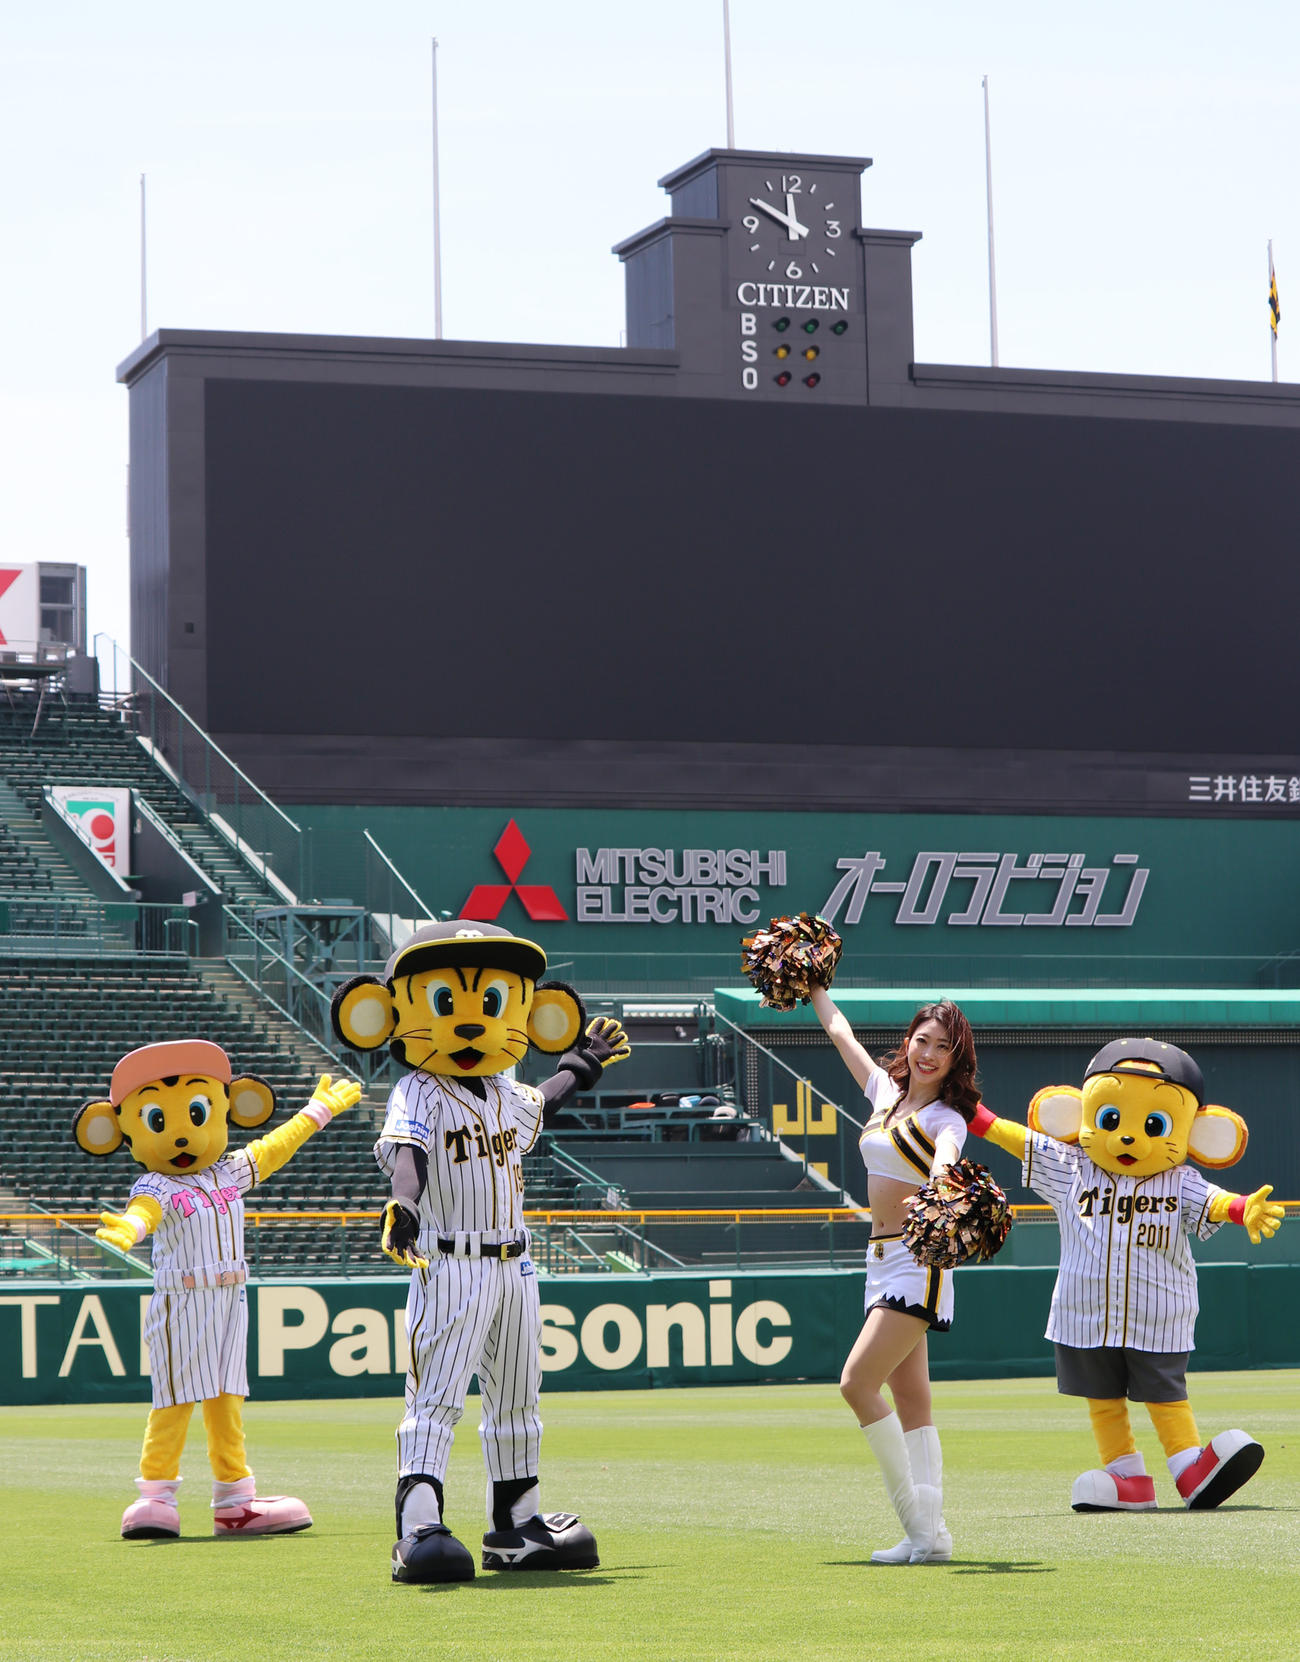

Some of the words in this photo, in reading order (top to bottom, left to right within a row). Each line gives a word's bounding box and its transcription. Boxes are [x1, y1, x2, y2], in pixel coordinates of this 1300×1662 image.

[783, 175, 802, 193] 12
[742, 216, 760, 234] 9
[826, 220, 841, 238] 3
[786, 262, 802, 279] 6
[737, 282, 850, 311] CITIZEN
[741, 312, 757, 335] B
[741, 340, 758, 362] S
[742, 367, 758, 389] O
[576, 847, 788, 887] MITSUBISHI
[819, 851, 1150, 926] オーロラビジョン
[576, 886, 761, 924] ELECTRIC
[1078, 1187, 1178, 1223] Tigers
[1136, 1224, 1170, 1249] 2011
[257, 1280, 793, 1377] Pasonic
